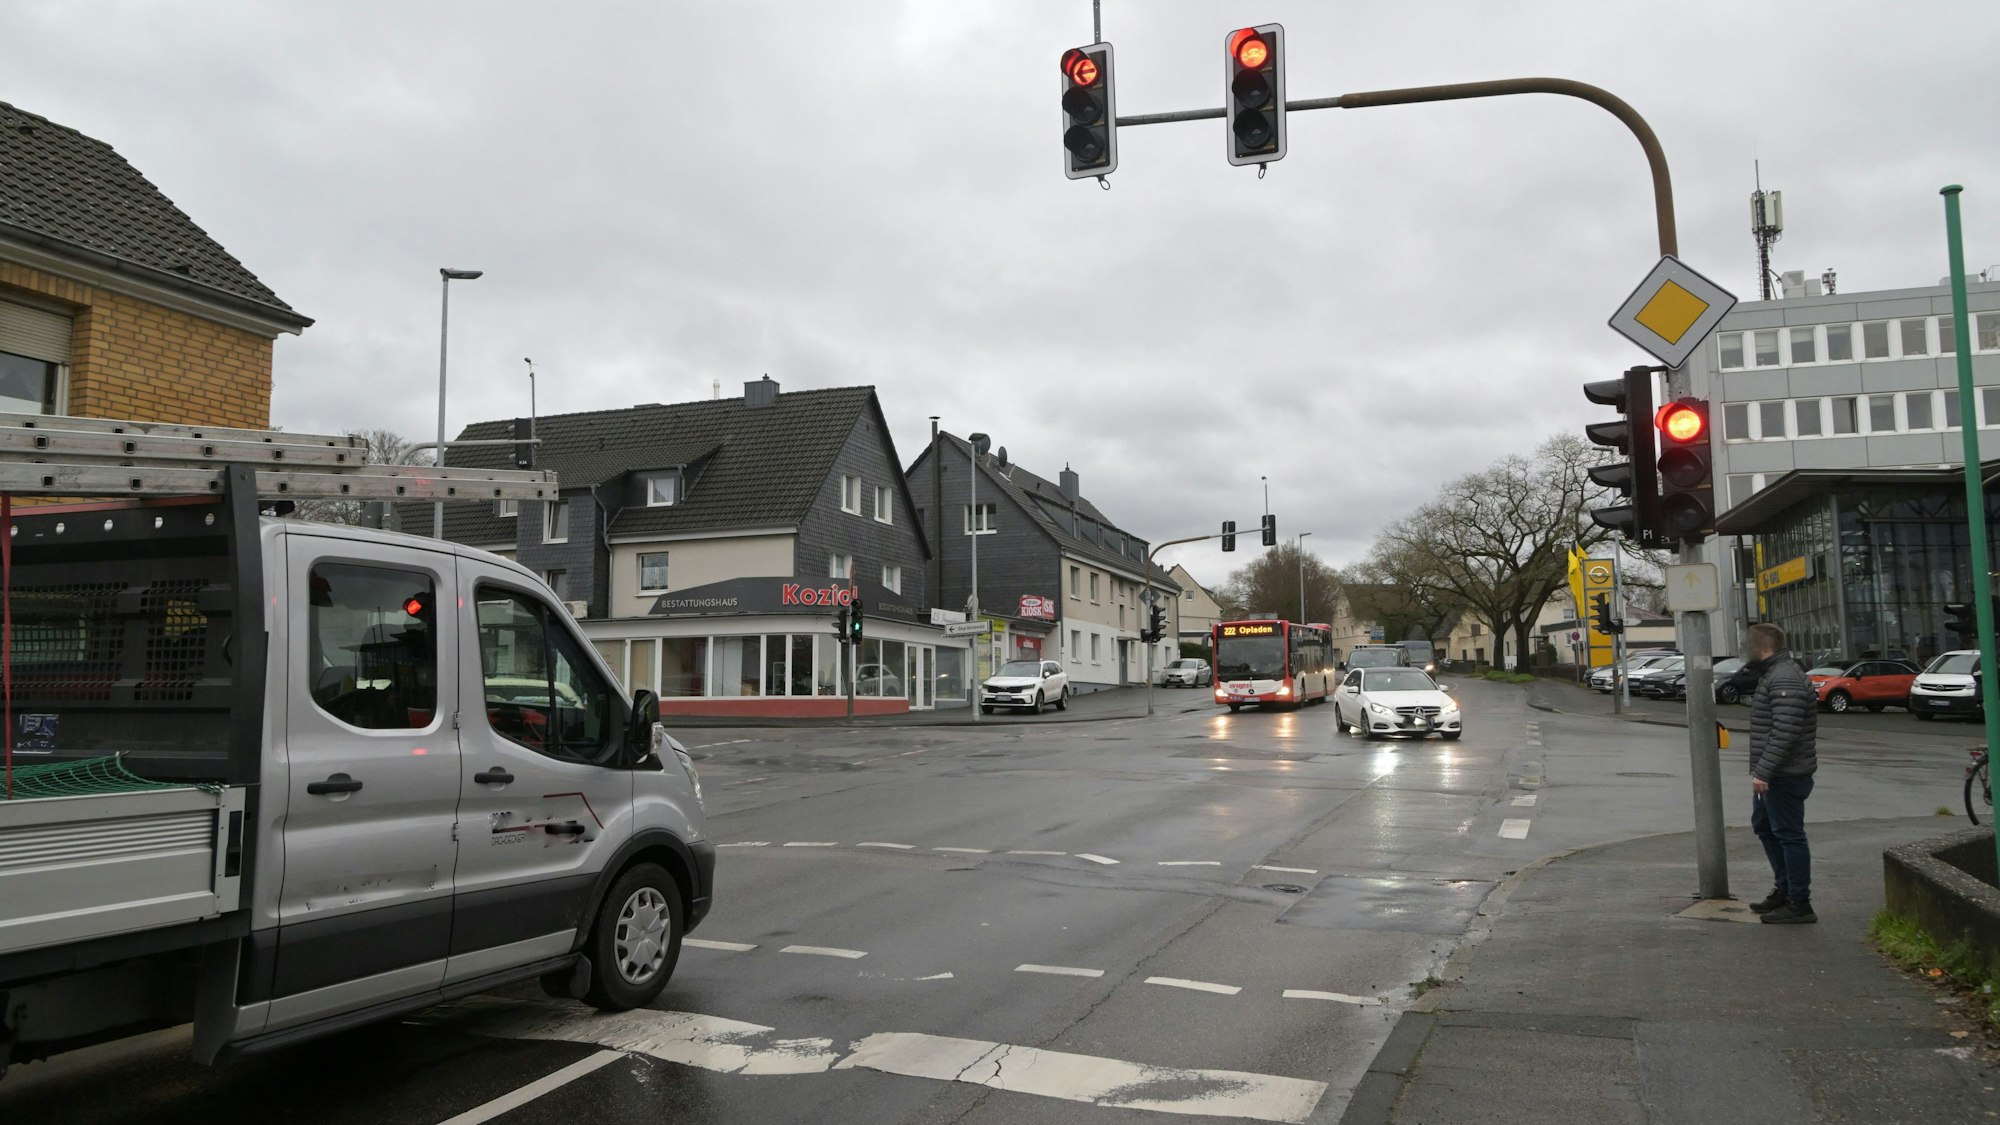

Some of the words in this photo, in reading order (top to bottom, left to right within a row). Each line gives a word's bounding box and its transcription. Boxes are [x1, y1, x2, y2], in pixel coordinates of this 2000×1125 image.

[1642, 529, 1653, 540] F1
[661, 597, 738, 608] BESTATTUNGSHAUS
[1021, 606, 1042, 616] KIOSK
[1224, 627, 1236, 635] 222
[1239, 625, 1272, 634] Opladen
